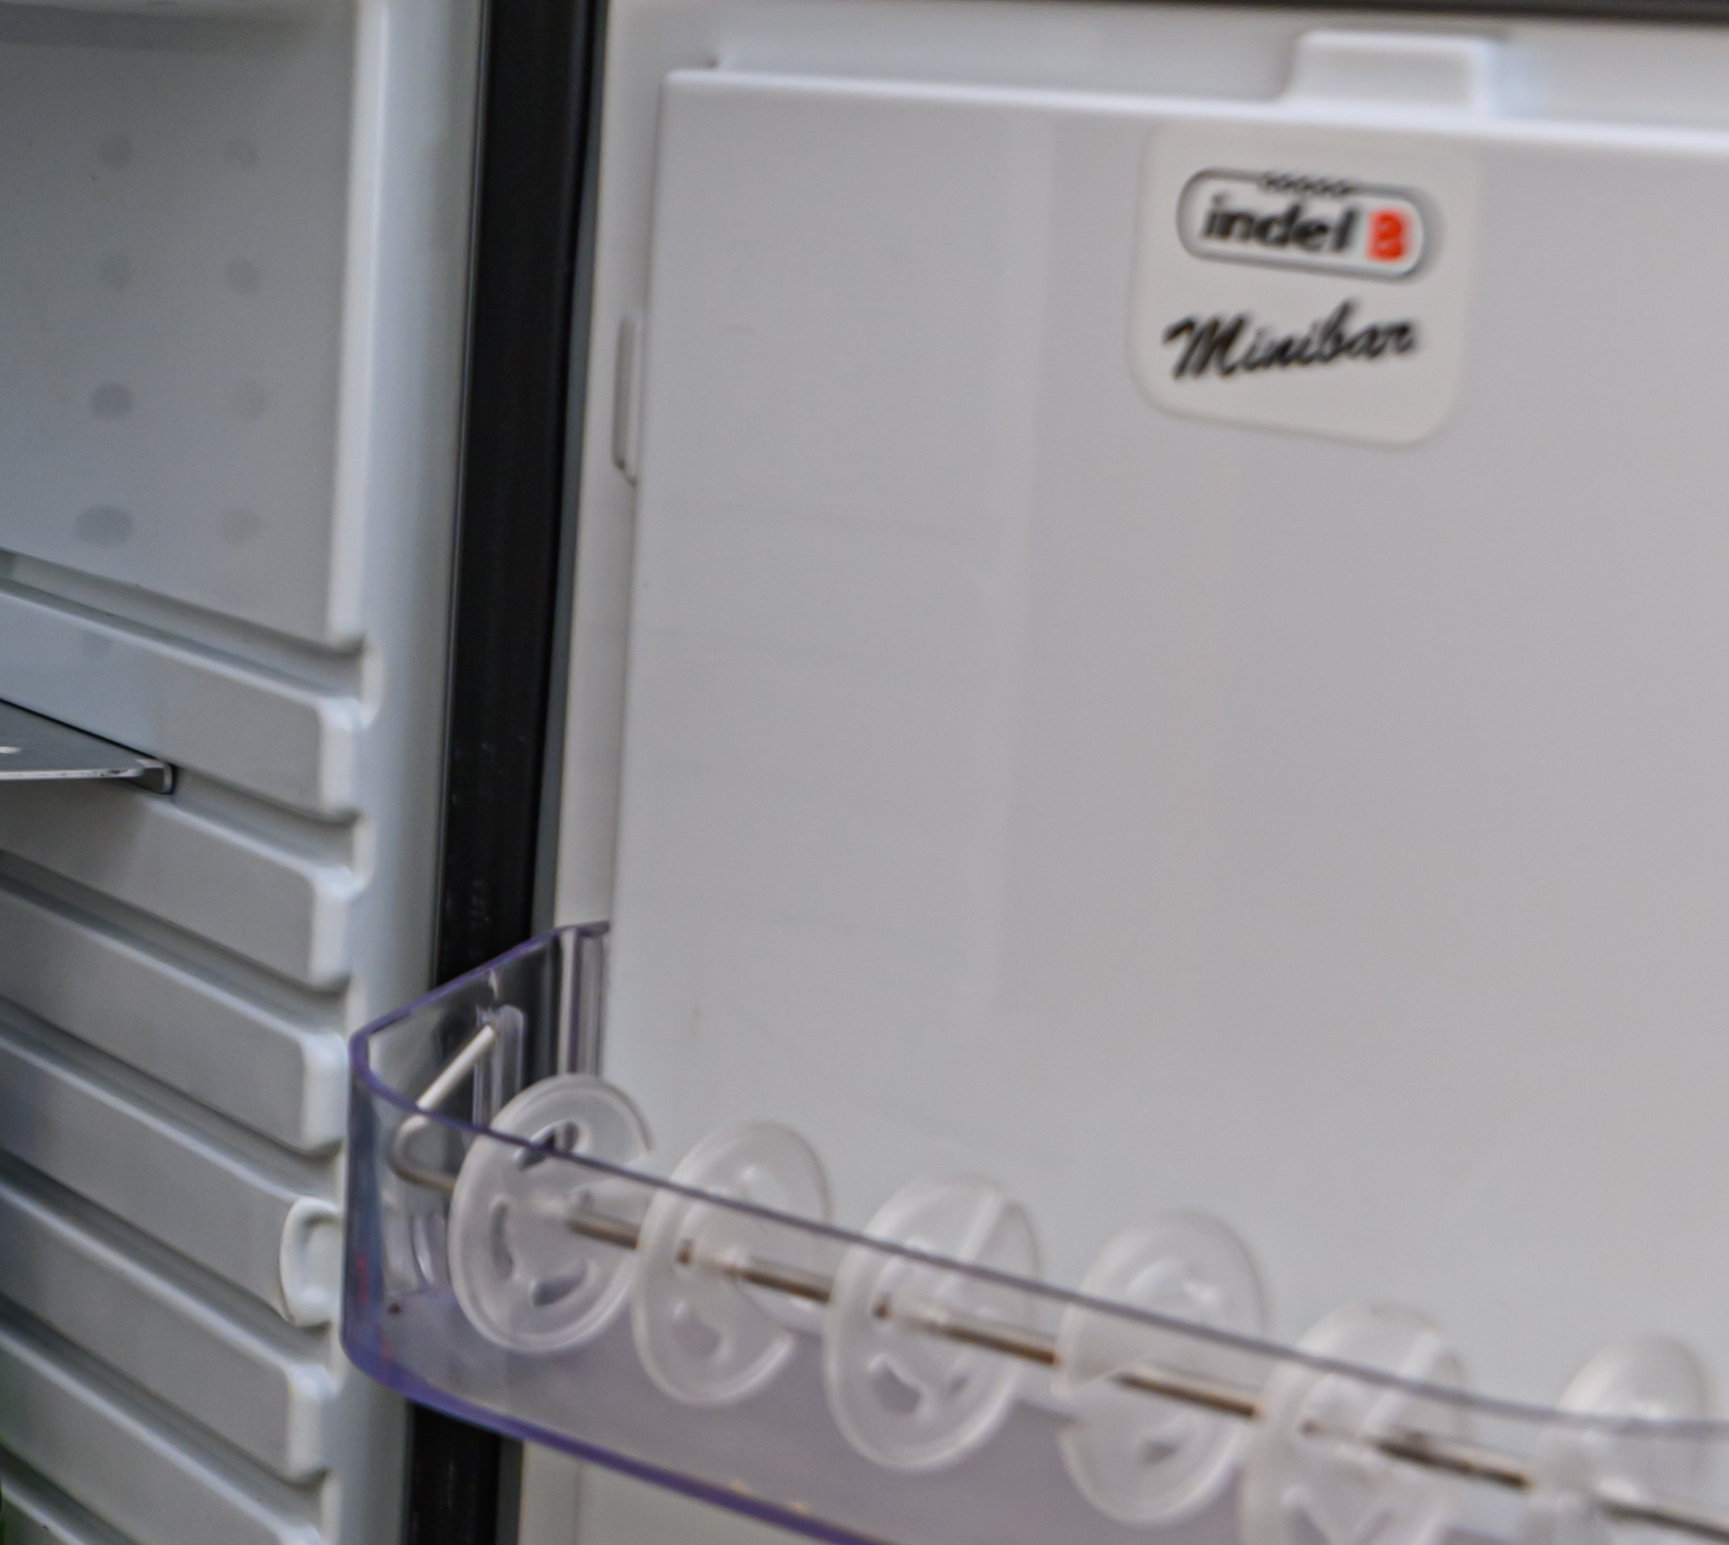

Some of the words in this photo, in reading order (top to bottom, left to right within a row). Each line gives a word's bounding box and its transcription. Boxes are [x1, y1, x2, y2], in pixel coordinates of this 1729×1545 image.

[1201, 191, 1359, 254] indel
[1366, 208, 1410, 263] B
[1162, 298, 1417, 379] Minibar
